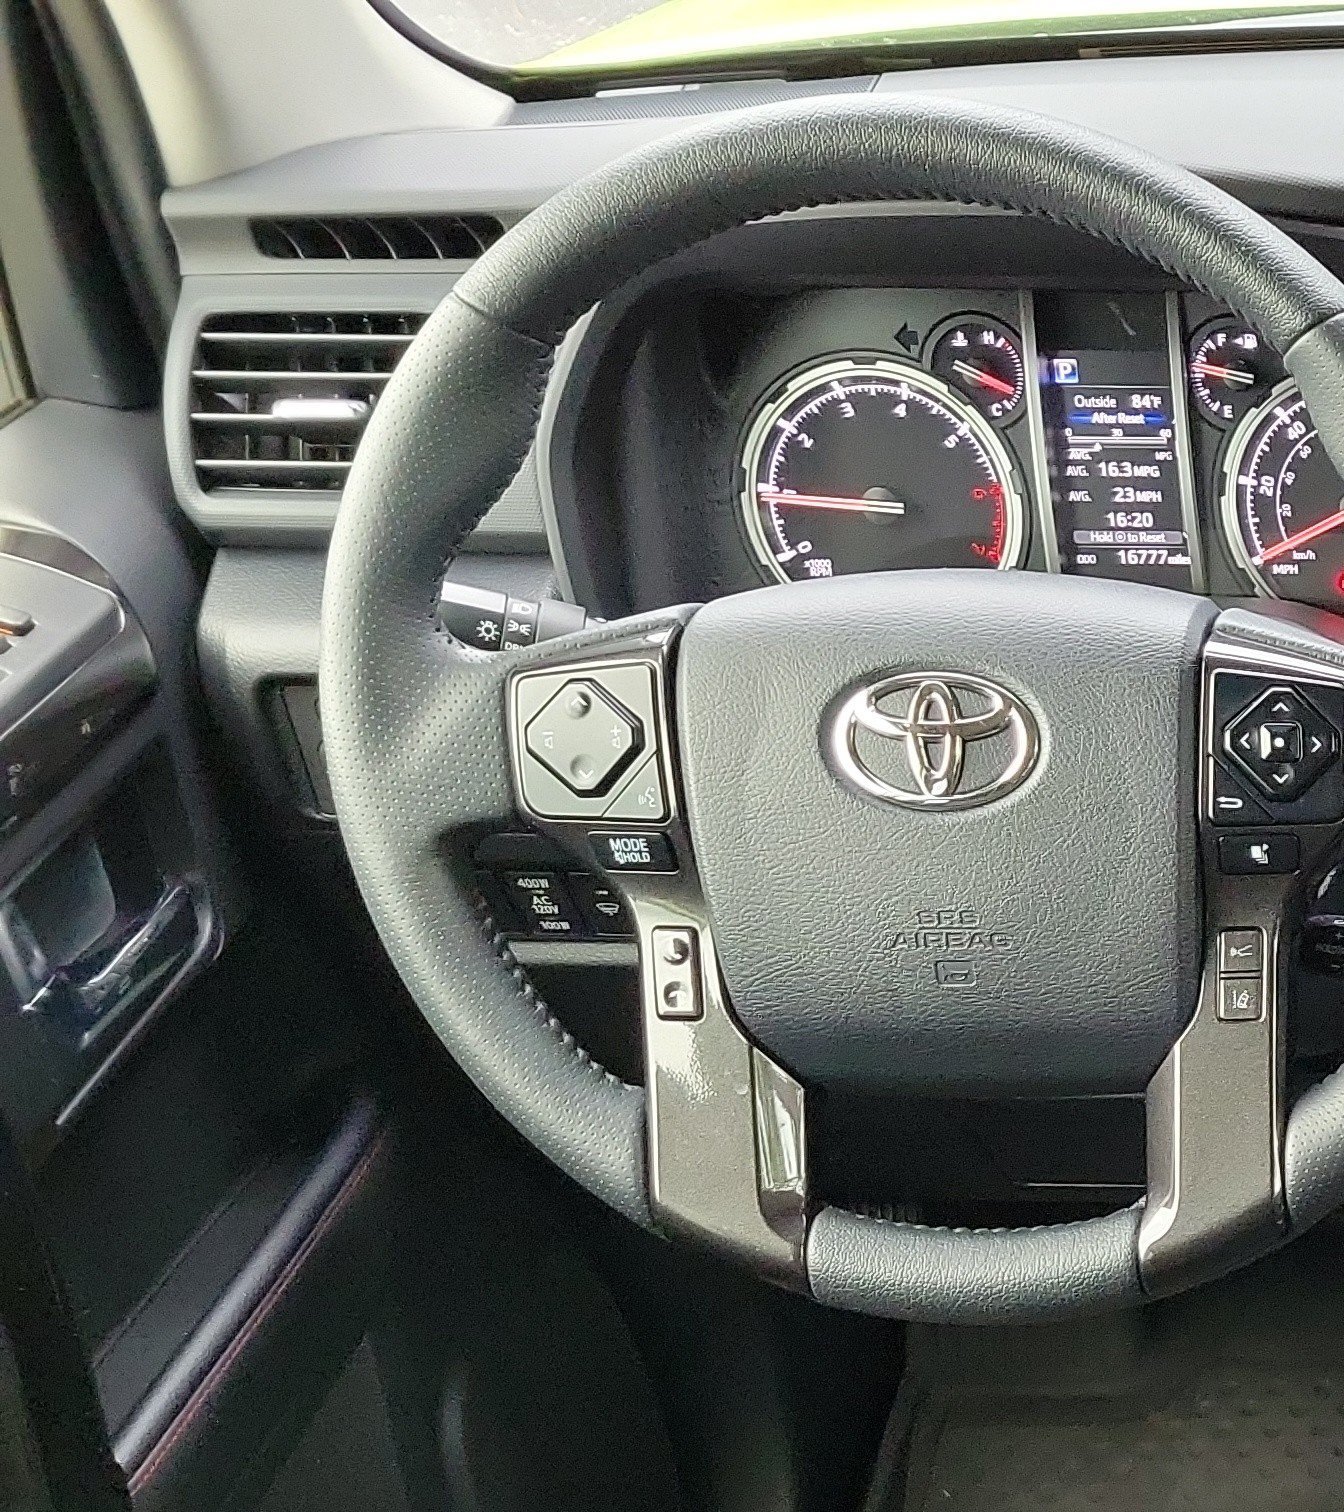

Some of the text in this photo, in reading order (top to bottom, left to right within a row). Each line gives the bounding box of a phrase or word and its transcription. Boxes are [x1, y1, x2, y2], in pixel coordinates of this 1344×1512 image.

[982, 330, 995, 345] H
[1217, 333, 1227, 346] F
[1074, 394, 1117, 408] Outside
[839, 402, 855, 418] 3
[892, 403, 908, 418] 4
[991, 402, 1002, 417] C
[1223, 405, 1234, 419] E
[1091, 412, 1146, 424] After Reset
[1287, 421, 1307, 441] 40
[797, 433, 815, 449] 2
[942, 434, 960, 449] 5
[1098, 461, 1133, 478] 16.3
[1259, 475, 1276, 498] 20
[1284, 471, 1296, 487] 40
[1111, 486, 1135, 503] 23
[1281, 503, 1292, 518] 20
[1106, 511, 1154, 528] 16:20
[1089, 531, 1114, 542] Hold
[1139, 531, 1166, 542] Reset
[797, 540, 813, 554] 0
[1117, 549, 1168, 565] 16777
[1272, 564, 1299, 575] MPH
[608, 837, 650, 852] MODE
[624, 851, 651, 864] HOLD
[516, 877, 550, 889] 400W
[532, 895, 553, 905] AC
[890, 931, 1014, 951] AIRBAG
